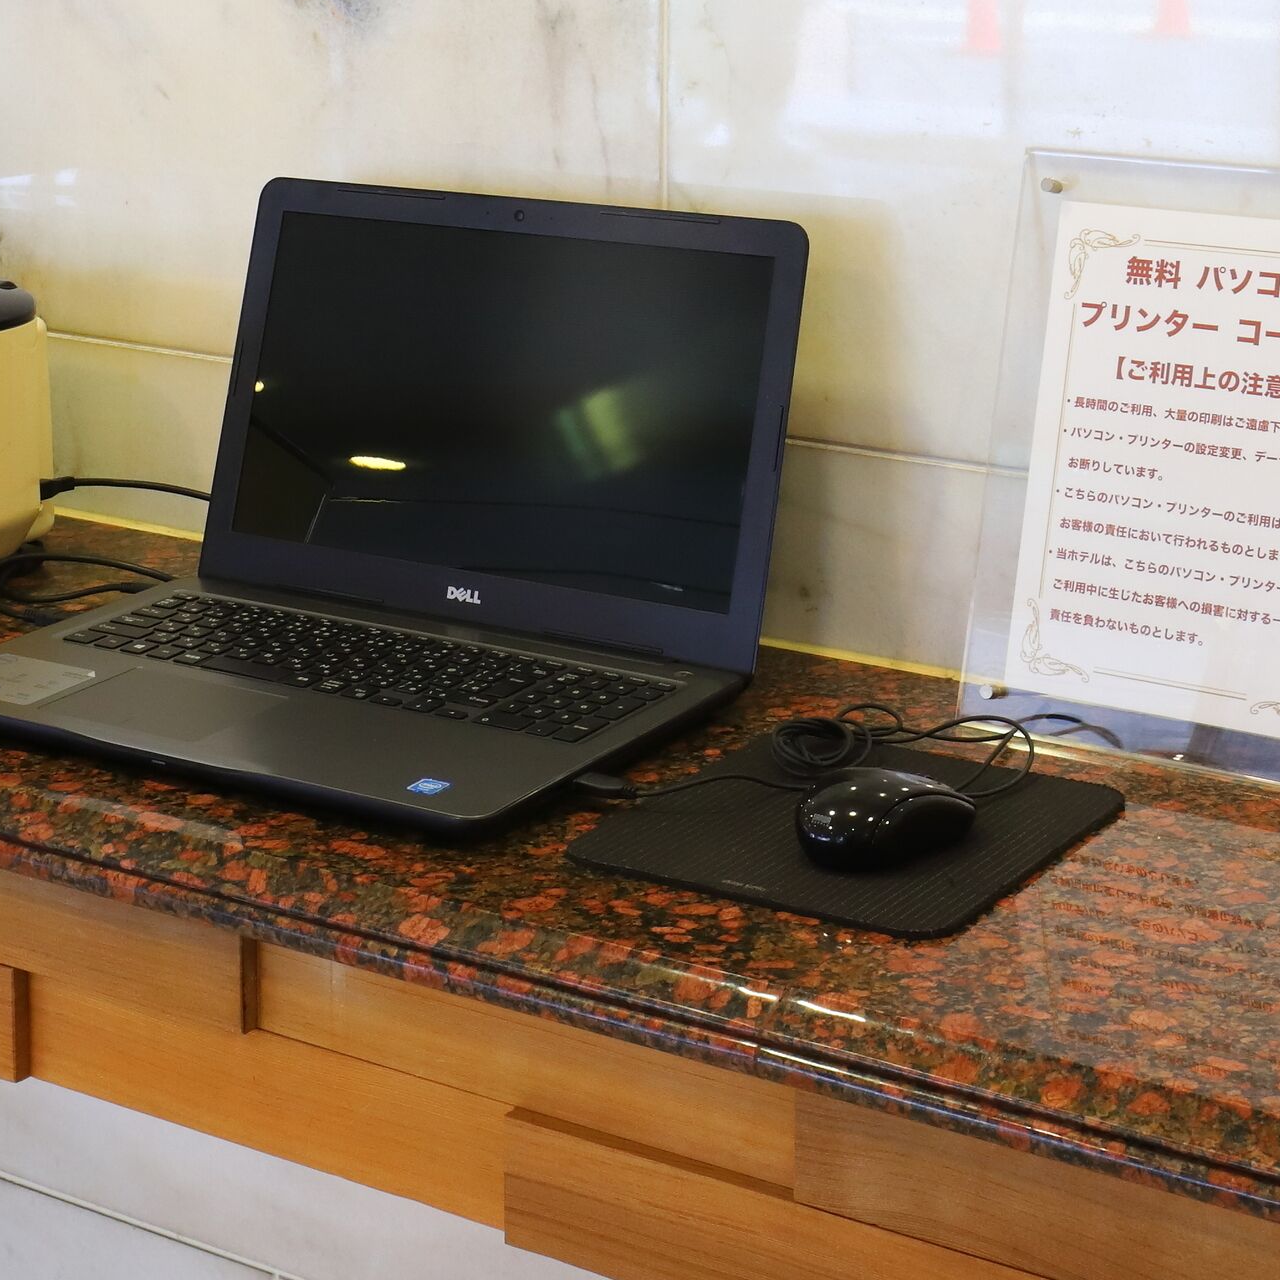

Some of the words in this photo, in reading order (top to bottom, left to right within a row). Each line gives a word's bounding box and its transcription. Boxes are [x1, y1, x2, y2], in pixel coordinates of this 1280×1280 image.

[1125, 254, 1182, 291] 無料
[1080, 300, 1220, 339] プリンター
[1067, 456, 1164, 482] お断りしています。
[446, 586, 481, 605] DELL
[1048, 608, 1205, 647] 責任を負わないものとします。
